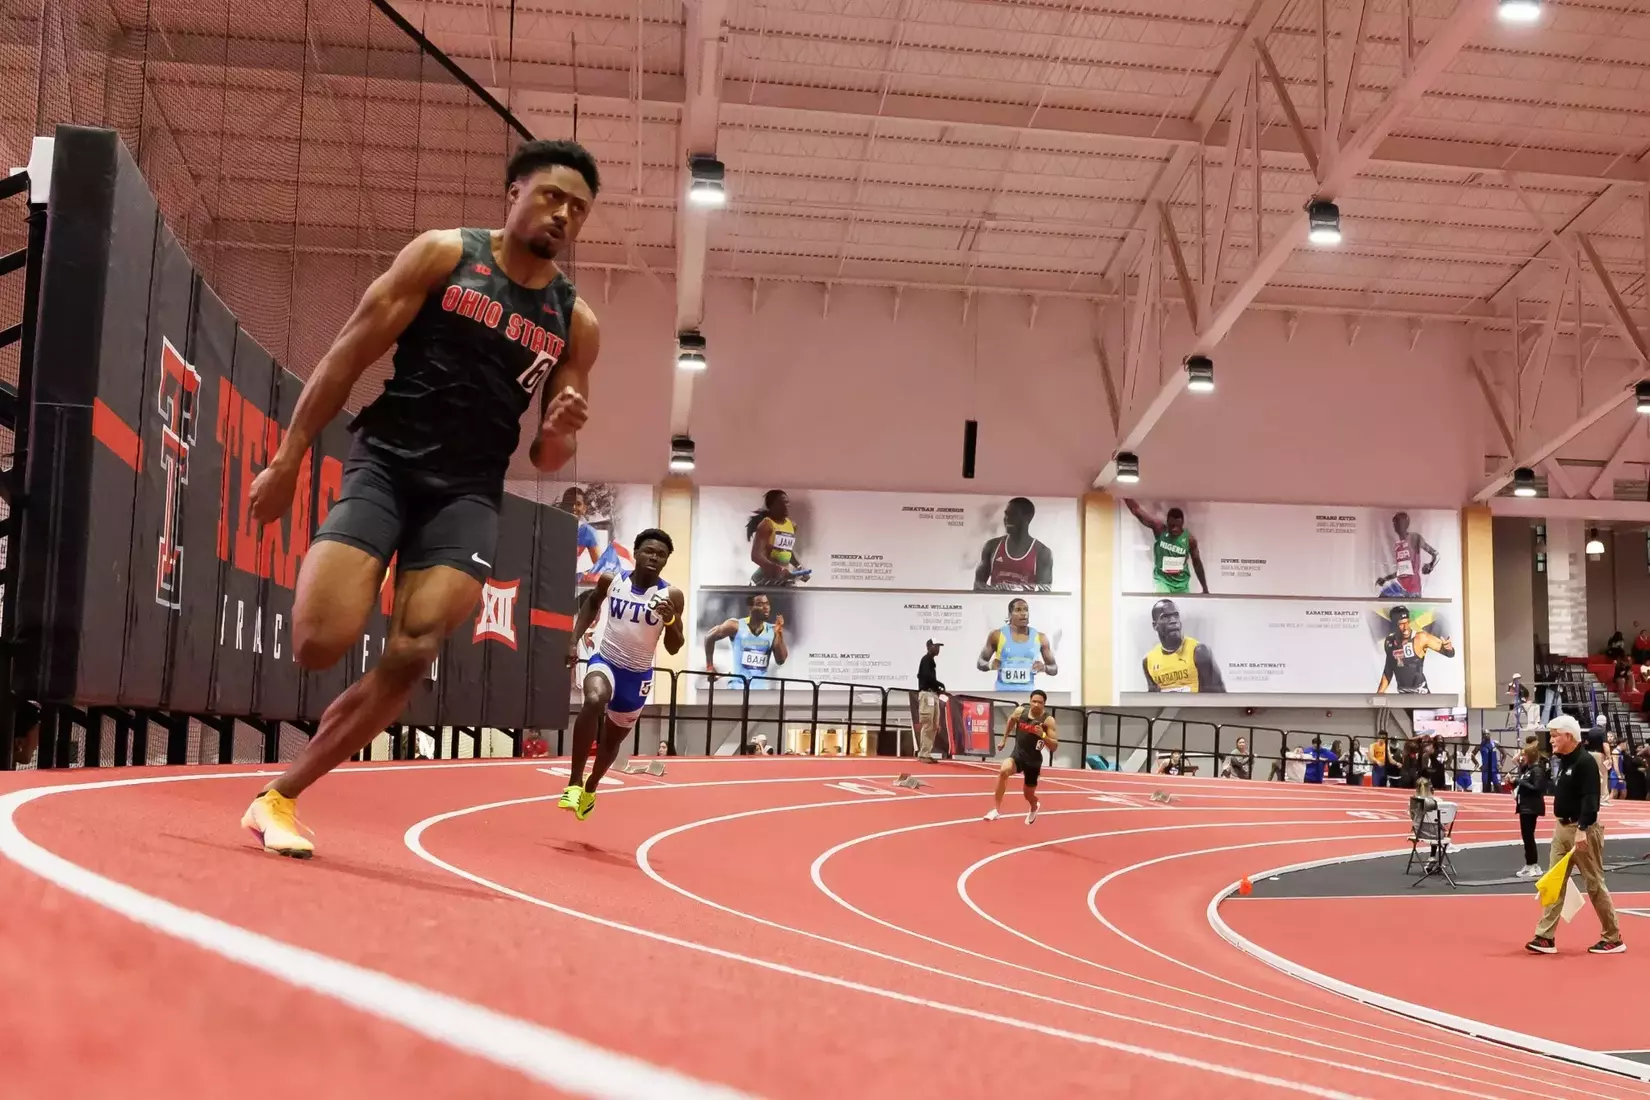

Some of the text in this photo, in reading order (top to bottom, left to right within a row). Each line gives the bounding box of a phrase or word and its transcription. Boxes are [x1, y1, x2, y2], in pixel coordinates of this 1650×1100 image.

[442, 285, 564, 359] OHIO STATE
[523, 357, 553, 389] 6
[1405, 645, 1412, 657] 6
[746, 655, 766, 665] BAH
[1005, 670, 1026, 680] BAH
[641, 681, 651, 695] 5
